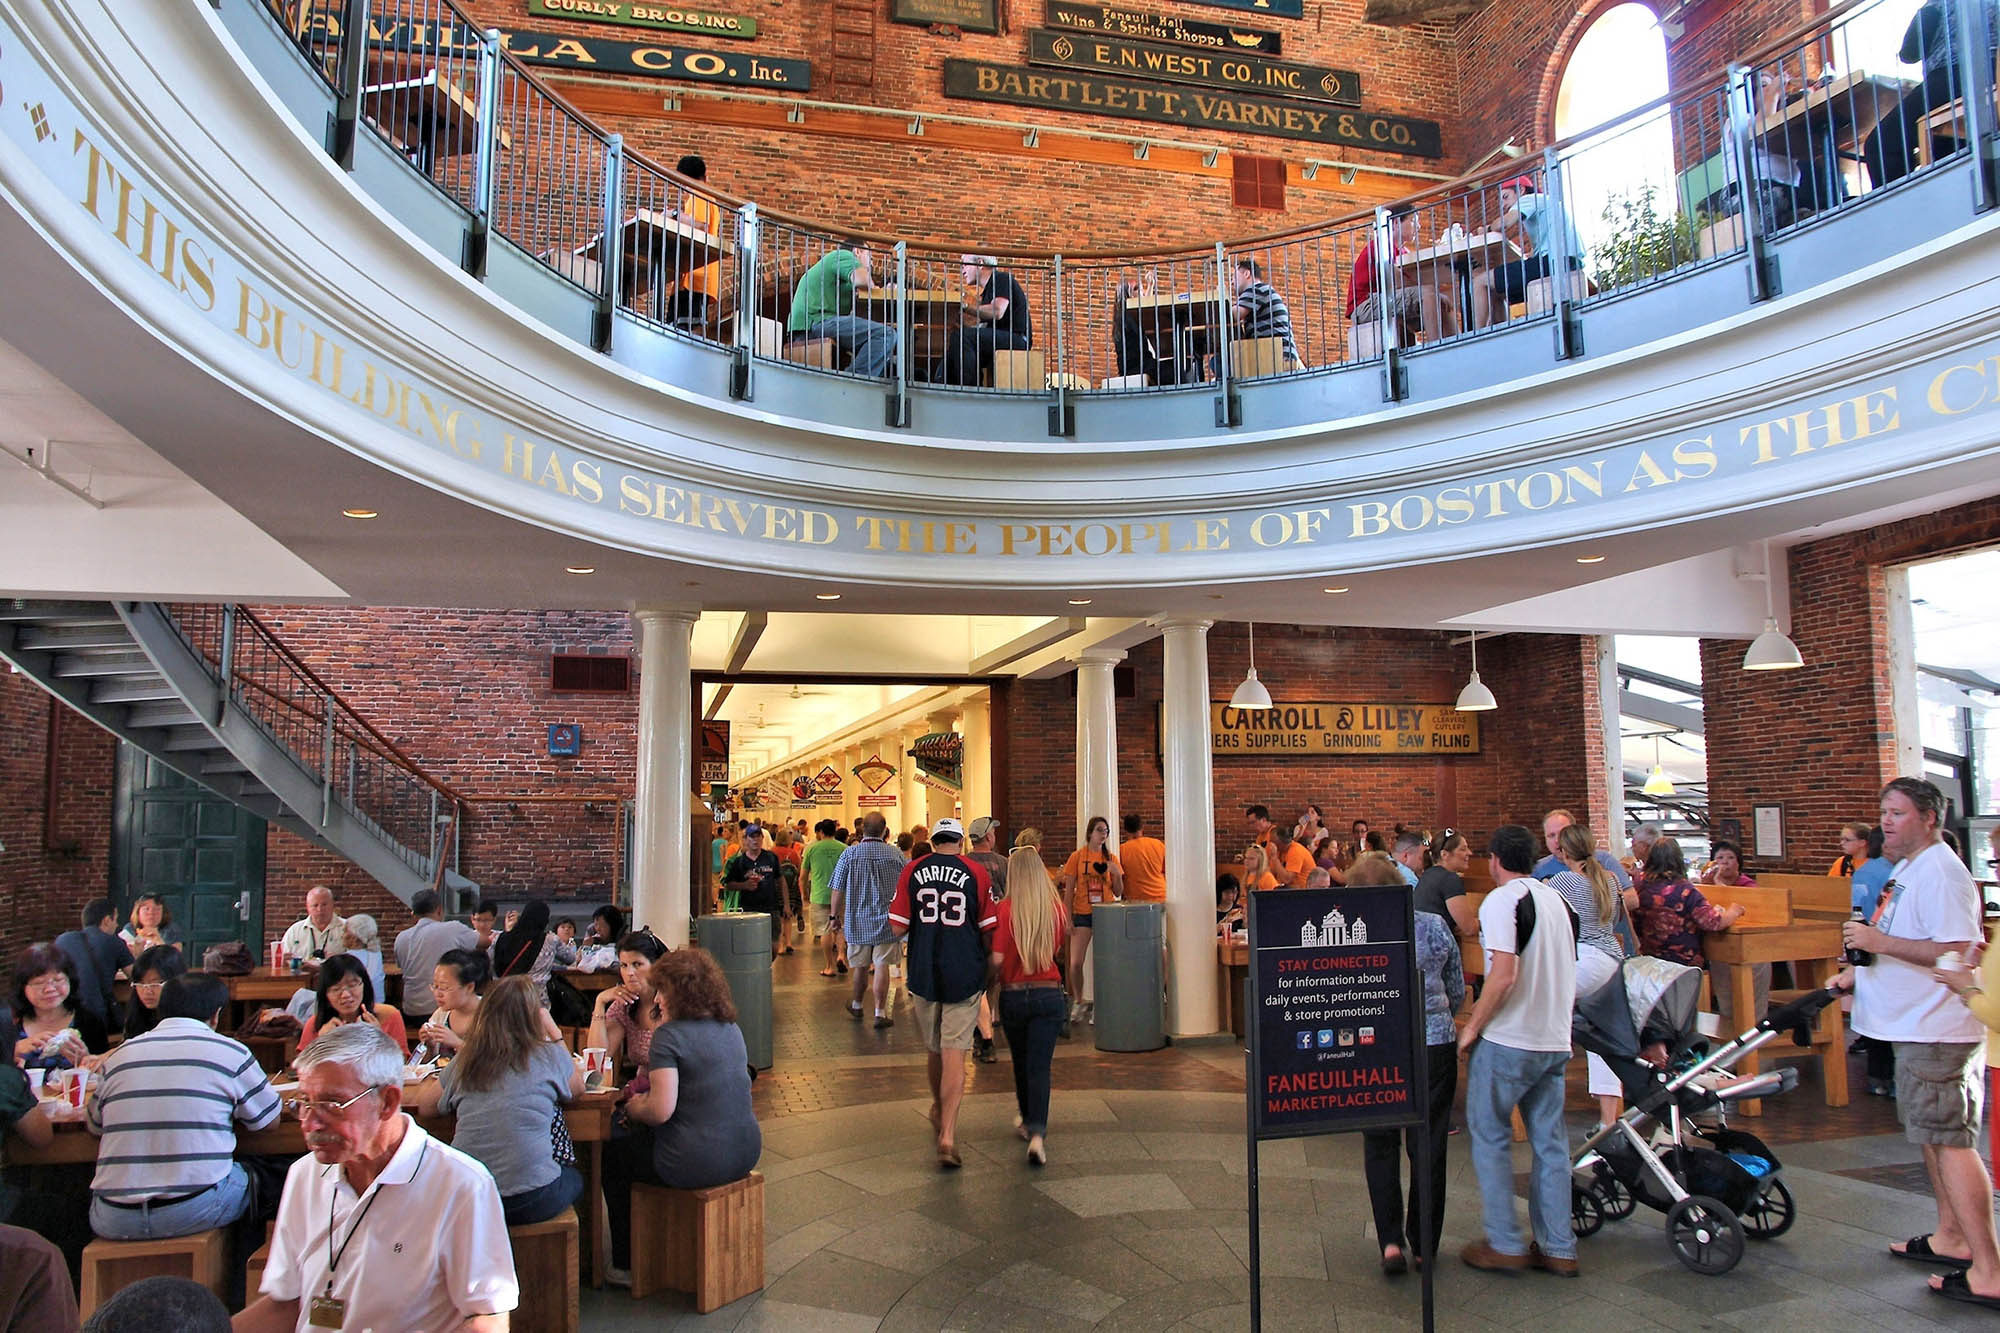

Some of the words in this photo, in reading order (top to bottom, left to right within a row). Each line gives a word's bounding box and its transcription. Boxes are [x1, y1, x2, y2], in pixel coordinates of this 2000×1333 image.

[544, 0, 621, 16] CURLY
[1057, 12, 1096, 28] Wine
[1103, 18, 1113, 30] &
[1120, 20, 1167, 38] Spirits
[1174, 27, 1225, 46] Shoppe
[1159, 16, 1183, 29] Hall
[631, 48, 737, 78] CO.
[750, 59, 788, 83] Inc.
[1193, 95, 1329, 134] VARNEY
[1337, 114, 1362, 139] &
[73, 126, 216, 313] THIS
[234, 277, 484, 460] BUILDING
[503, 432, 604, 504] HAS
[619, 474, 839, 545] SERVED
[856, 515, 978, 555] THE
[1000, 516, 1230, 557] PEOPLE
[1249, 507, 1331, 548] OF
[1348, 460, 1607, 538] BOSTON
[1623, 434, 1718, 493] AS
[1740, 386, 1899, 466] THE
[1927, 355, 2000, 415] C
[1221, 704, 1326, 730] CARROLL
[1336, 707, 1354, 730] &
[1362, 706, 1424, 731] LILEY
[1211, 733, 1239, 748] ERS
[1246, 732, 1307, 748] SUPPLIES
[1323, 732, 1382, 748] GRINDING
[1397, 732, 1425, 748] SAW
[1432, 732, 1471, 748] FILING
[914, 865, 971, 889] VARITEK
[916, 887, 967, 927] 33
[1278, 959, 1309, 972] STAY
[1311, 955, 1390, 970] CONNECTED
[1278, 978, 1293, 988] for
[1296, 974, 1355, 987] information
[1357, 973, 1387, 984] about
[1265, 994, 1290, 1007] daily
[1292, 992, 1329, 1004] events,
[1331, 989, 1400, 1002] performances
[1284, 1010, 1292, 1021] &
[1295, 1009, 1322, 1020] store
[1324, 1005, 1385, 1021] promotions!
[1268, 1066, 1405, 1094] FANEUILHALL
[1268, 1089, 1408, 1113] MARKETPLACE.COM
